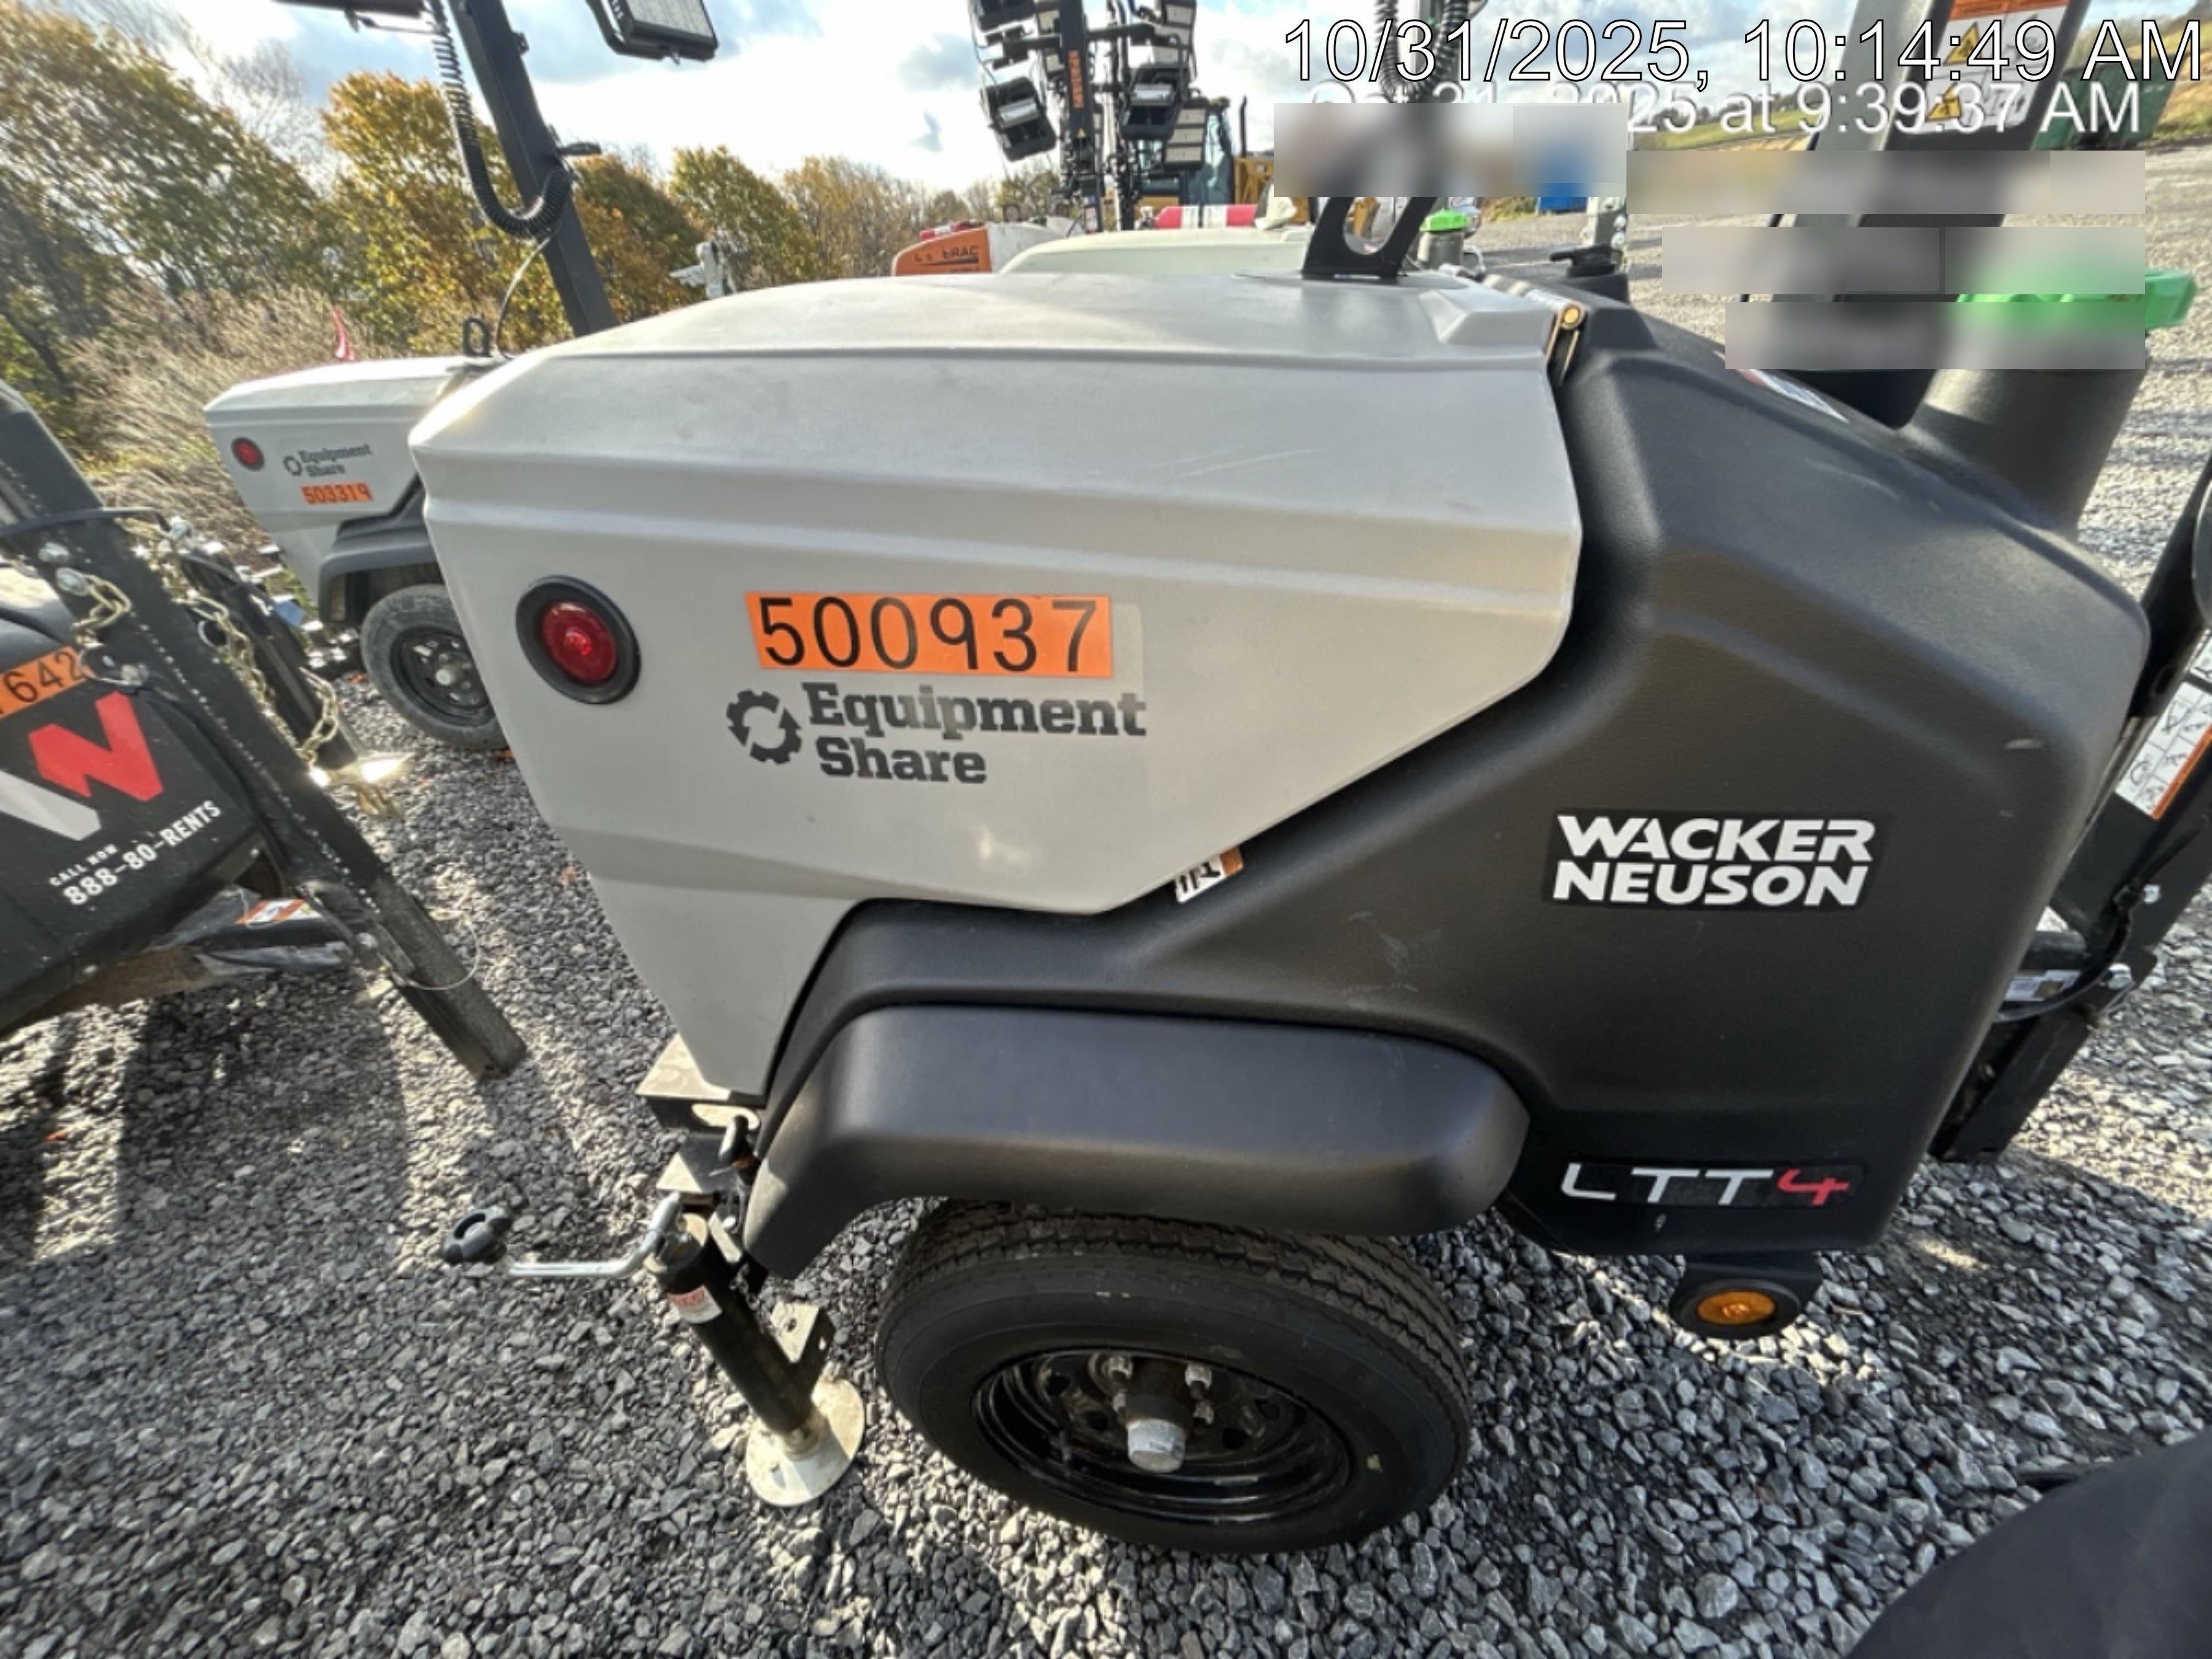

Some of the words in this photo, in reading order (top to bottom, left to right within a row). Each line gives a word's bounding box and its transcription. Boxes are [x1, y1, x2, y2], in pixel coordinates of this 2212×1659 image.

[298, 443, 372, 464] Equipment
[306, 463, 345, 477] Share
[300, 482, 373, 504] 503319
[759, 595, 1098, 672] 500937
[0, 651, 82, 714] 642
[801, 682, 1147, 739] Equipment
[816, 737, 987, 783] Share
[63, 800, 221, 905] 888-80-RENTS
[1558, 815, 1876, 861] WACKER
[49, 864, 87, 886] CALL
[1553, 861, 1869, 906] NEUSON
[1561, 1163, 1850, 1206] LTT4
